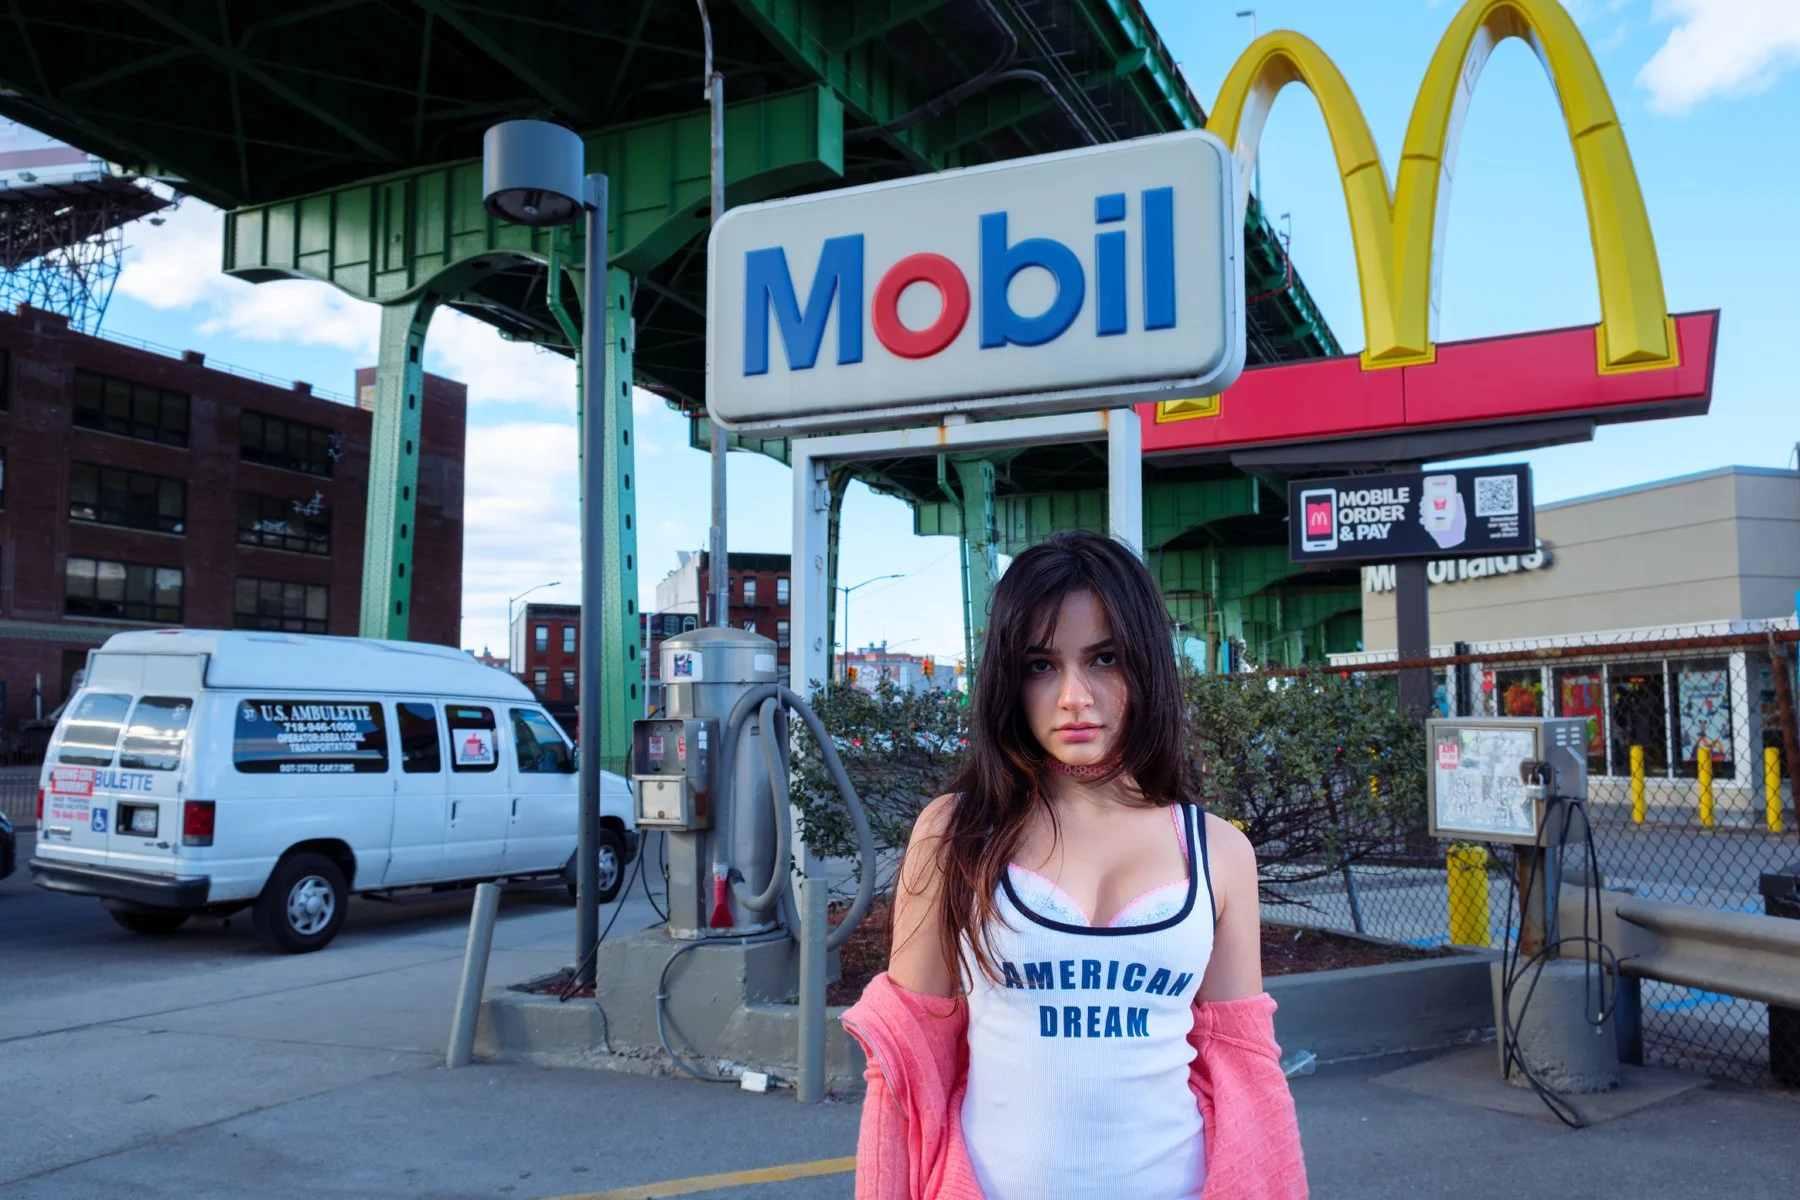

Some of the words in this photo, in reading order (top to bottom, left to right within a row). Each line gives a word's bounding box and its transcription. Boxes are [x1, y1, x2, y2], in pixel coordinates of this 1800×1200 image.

[743, 186, 1176, 377] Mobil
[1339, 487, 1410, 507] MOBILE
[1339, 505, 1405, 524] ORDER
[1340, 525, 1354, 542] &
[1357, 523, 1392, 540] PAY
[260, 705, 288, 721] U.S.
[291, 705, 372, 721] AMBULETTE
[289, 742, 357, 752] TRANSPORTATION
[1442, 744, 1455, 752] AIR
[1002, 959, 1194, 997] AMERICAN
[1039, 1005, 1150, 1038] DREAM
